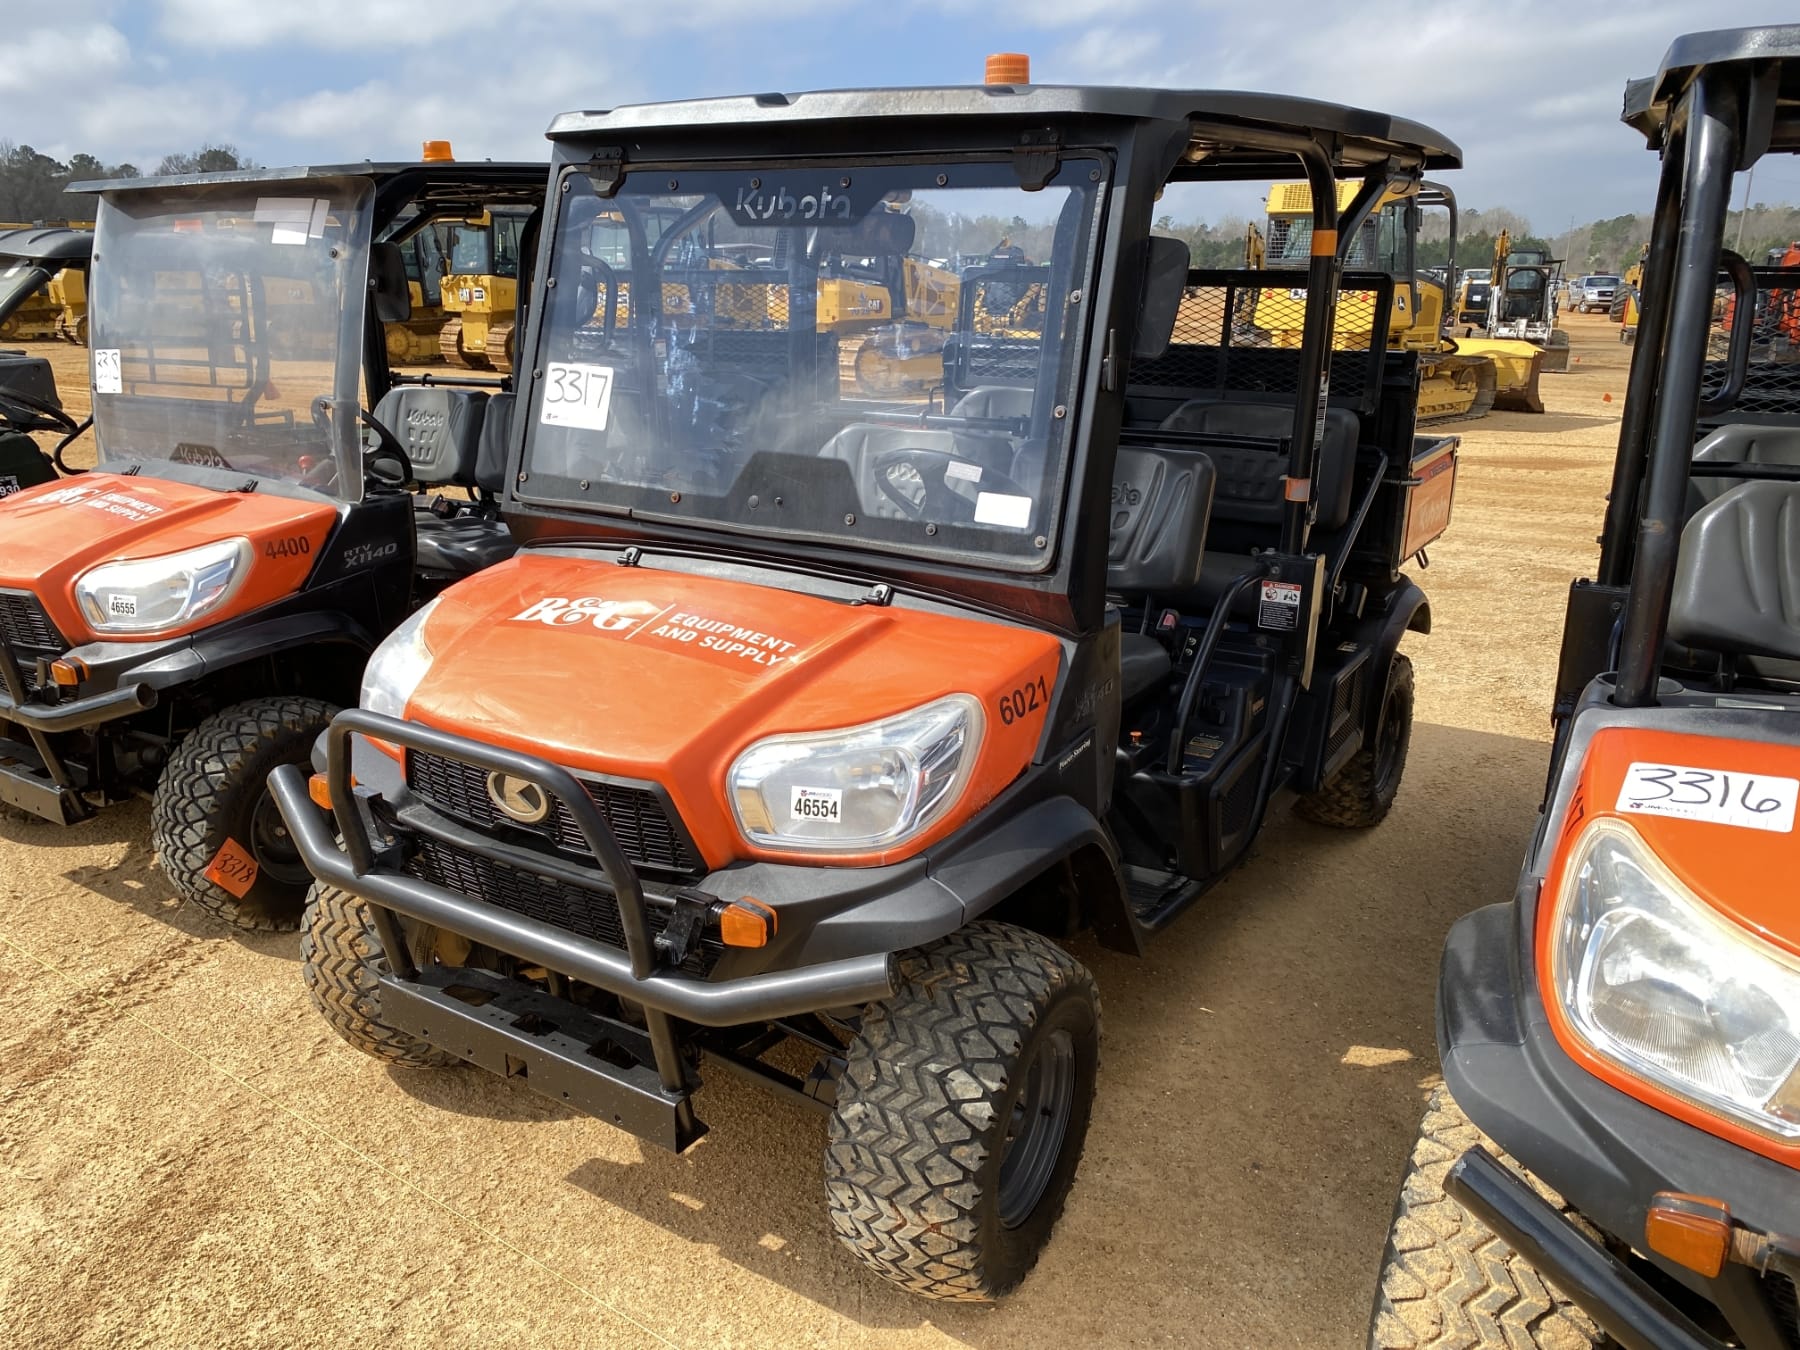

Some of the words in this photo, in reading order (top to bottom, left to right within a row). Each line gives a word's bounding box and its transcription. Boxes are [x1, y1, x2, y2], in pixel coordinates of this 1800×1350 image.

[735, 186, 851, 219] Kubota
[868, 299, 880, 311] CAT
[546, 367, 608, 408] 3317
[101, 492, 164, 515] EQUIPMENT
[105, 504, 149, 521] SUPPLY
[265, 536, 310, 559] 4400
[344, 543, 371, 557] RTV
[344, 542, 397, 568] X1140
[111, 601, 135, 615] 46555
[507, 596, 640, 631] B&G
[651, 624, 698, 643] AND
[699, 634, 785, 667] SUPPLY
[668, 612, 796, 653] EQUIPMENT
[999, 674, 1048, 725] 6021
[1627, 767, 1782, 814] 3316
[794, 797, 838, 818] 46554
[215, 853, 254, 883] 3318
